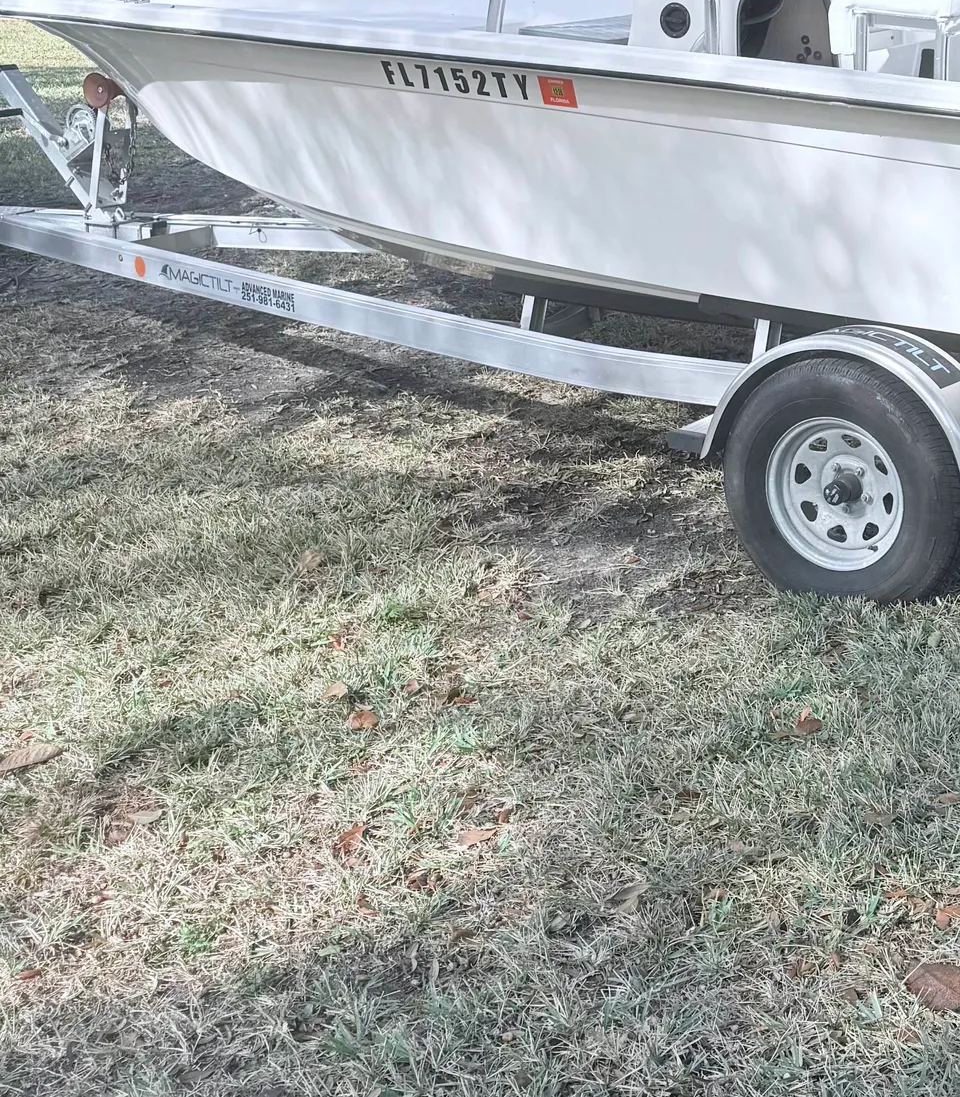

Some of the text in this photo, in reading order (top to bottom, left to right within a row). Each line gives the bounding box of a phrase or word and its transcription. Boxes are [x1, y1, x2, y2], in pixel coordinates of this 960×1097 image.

[168, 266, 233, 293] MAGICTILT
[241, 281, 295, 303] ADVANCED MARINE
[241, 291, 295, 313] 251-981-6431
